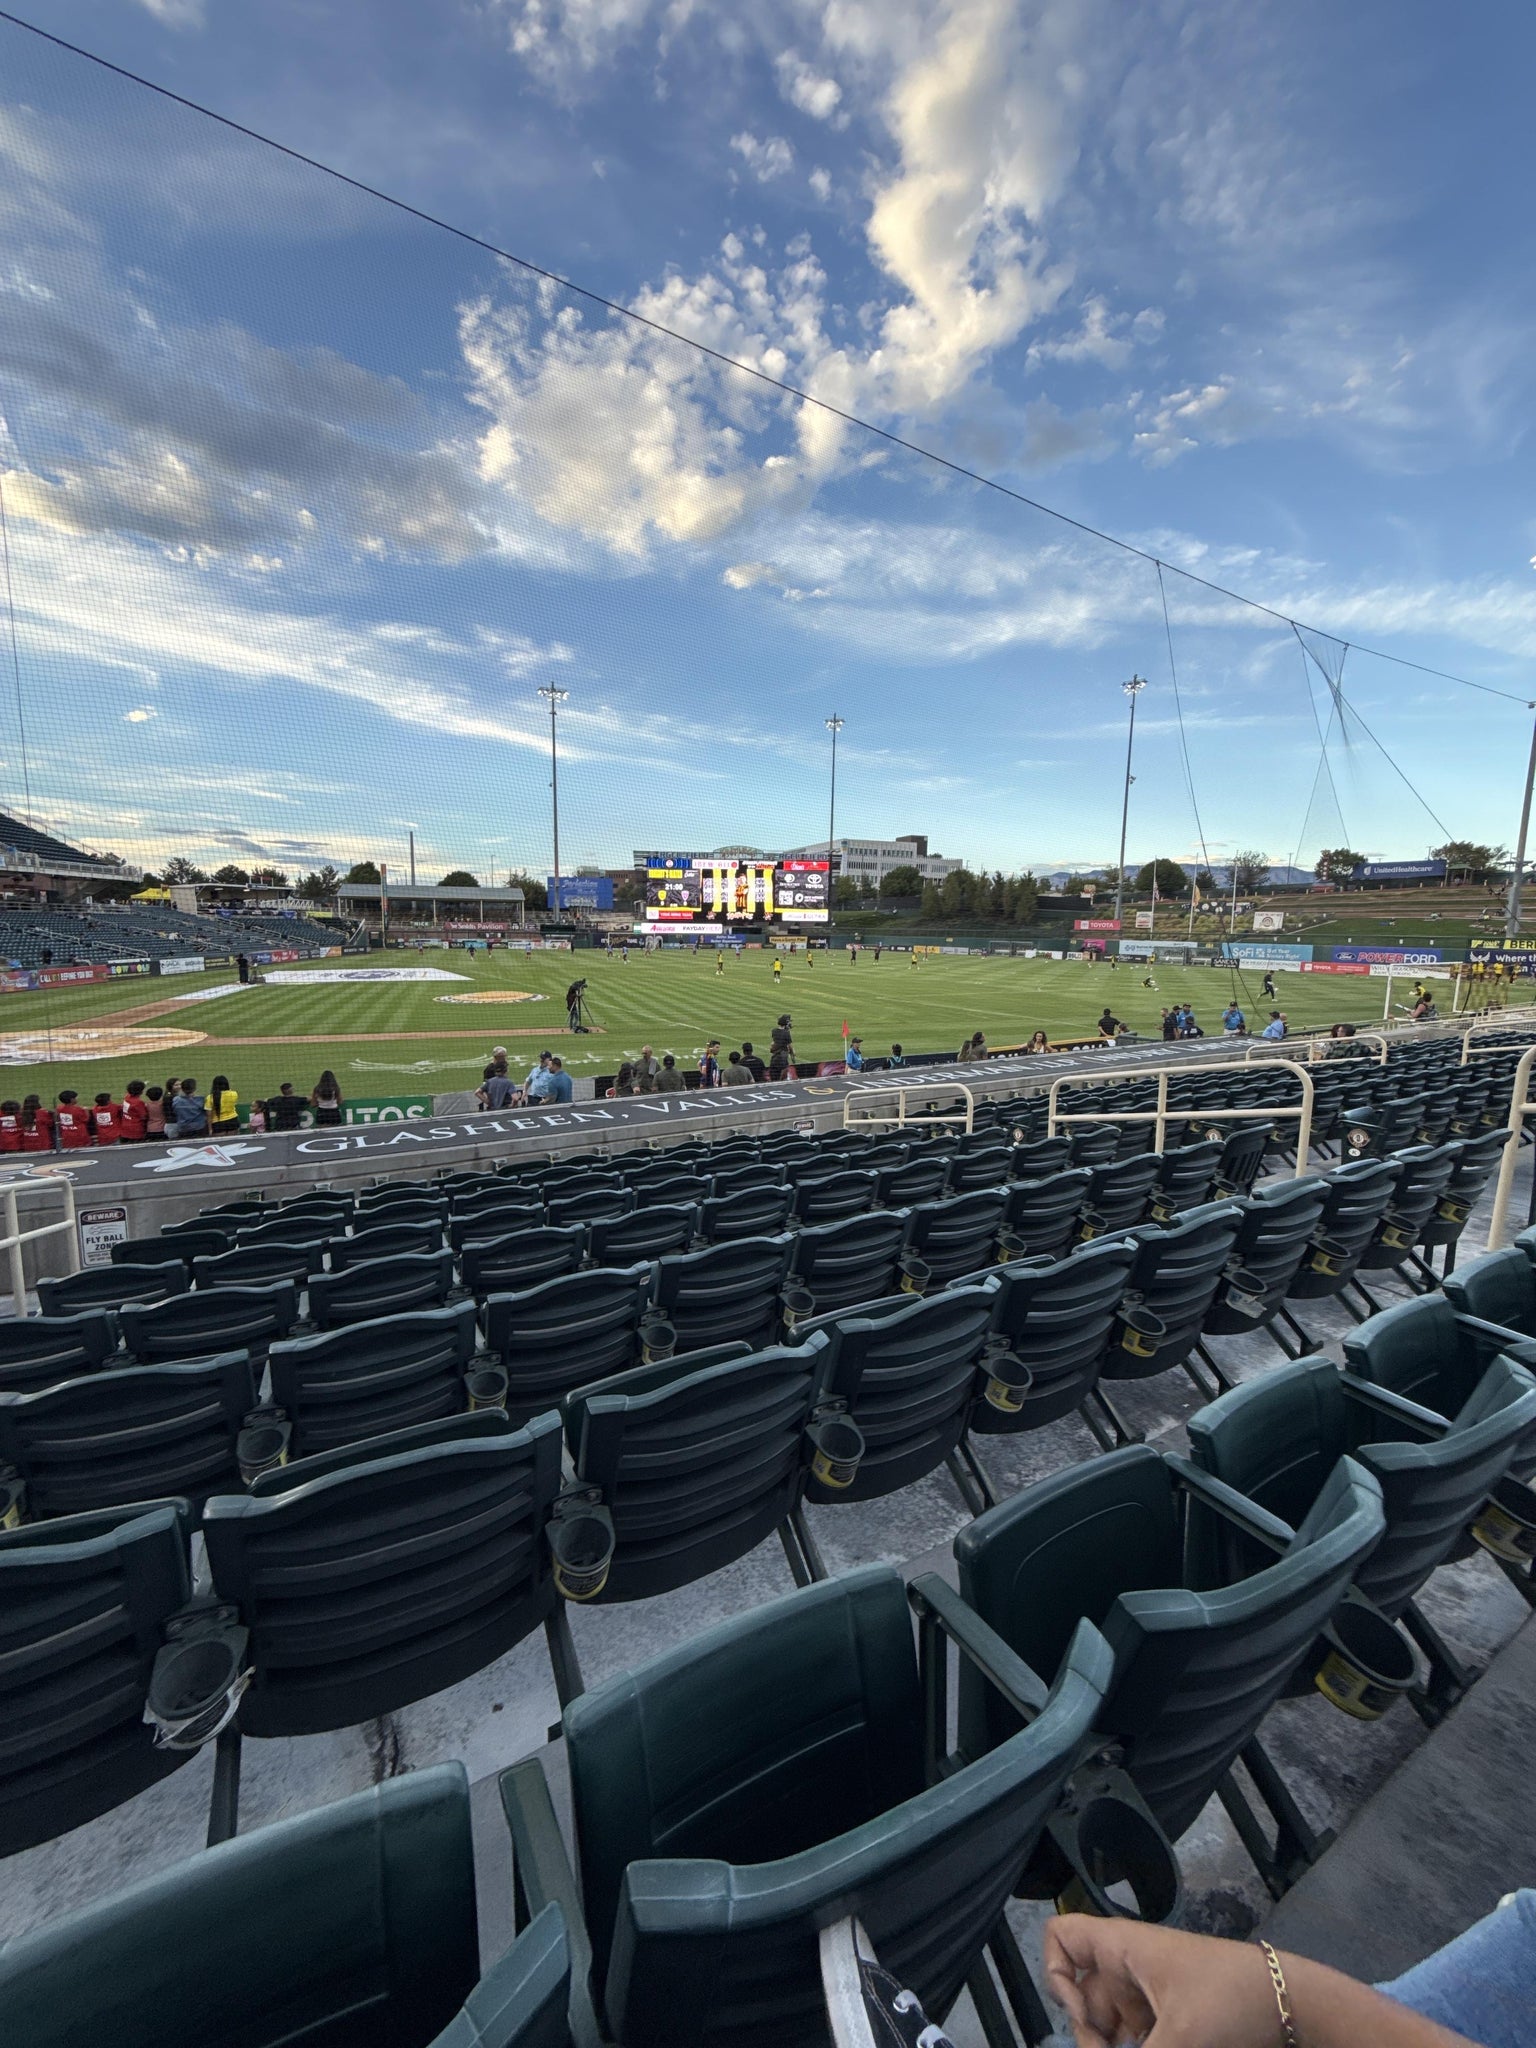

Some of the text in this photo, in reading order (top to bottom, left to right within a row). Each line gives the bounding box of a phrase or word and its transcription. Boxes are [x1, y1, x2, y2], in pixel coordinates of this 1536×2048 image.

[1510, 940, 1536, 949] BER
[1232, 947, 1254, 957] SoFi
[1495, 954, 1527, 963] Where
[40, 974, 52, 982] CALL
[296, 1109, 629, 1153] GLASHEEN,
[632, 1090, 796, 1113] VALLES
[803, 1086, 848, 1095] &
[843, 1064, 1043, 1090] INDERMAN,
[1042, 1057, 1083, 1069] LLP
[88, 1212, 119, 1221] BEWARE
[86, 1234, 125, 1244] FLY BALL
